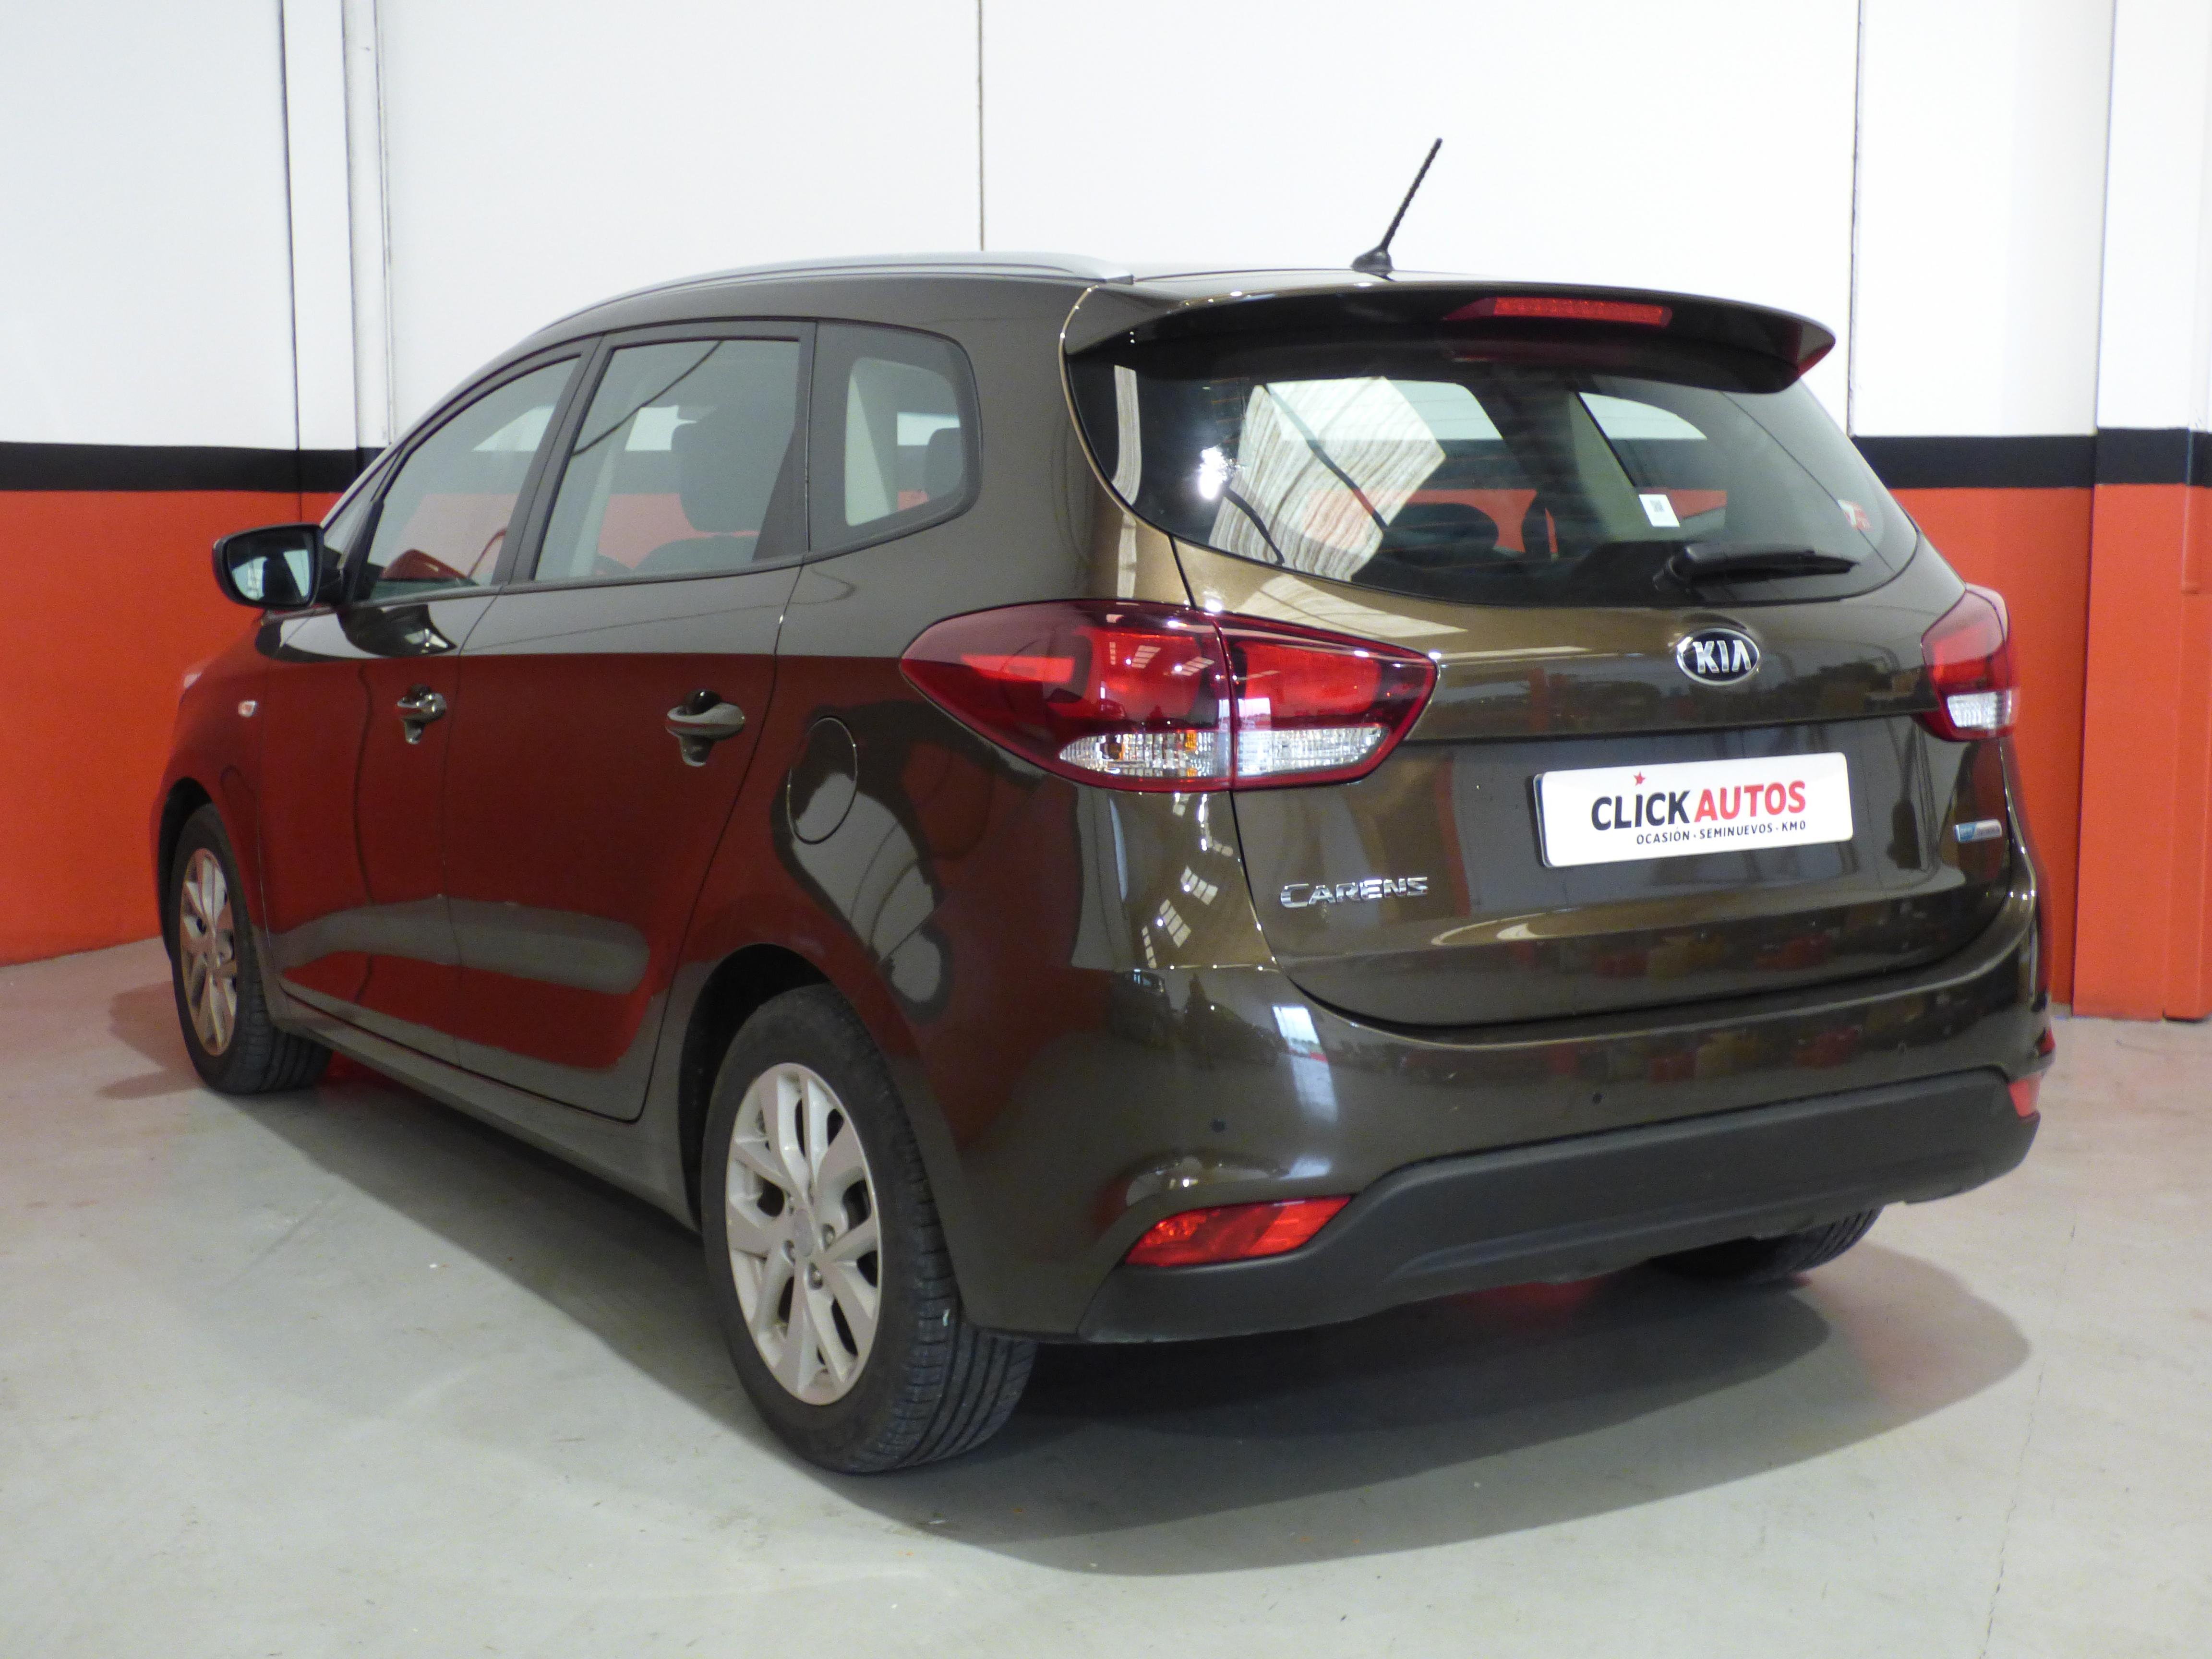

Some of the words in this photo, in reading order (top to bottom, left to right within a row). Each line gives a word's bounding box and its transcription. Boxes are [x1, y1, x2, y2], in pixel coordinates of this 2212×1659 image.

[1693, 640, 1752, 673] KIA
[1636, 827, 1690, 845] OCASIÓN
[1700, 823, 1772, 839] SEMINUEVOS
[1280, 877, 1428, 908] CARENS
